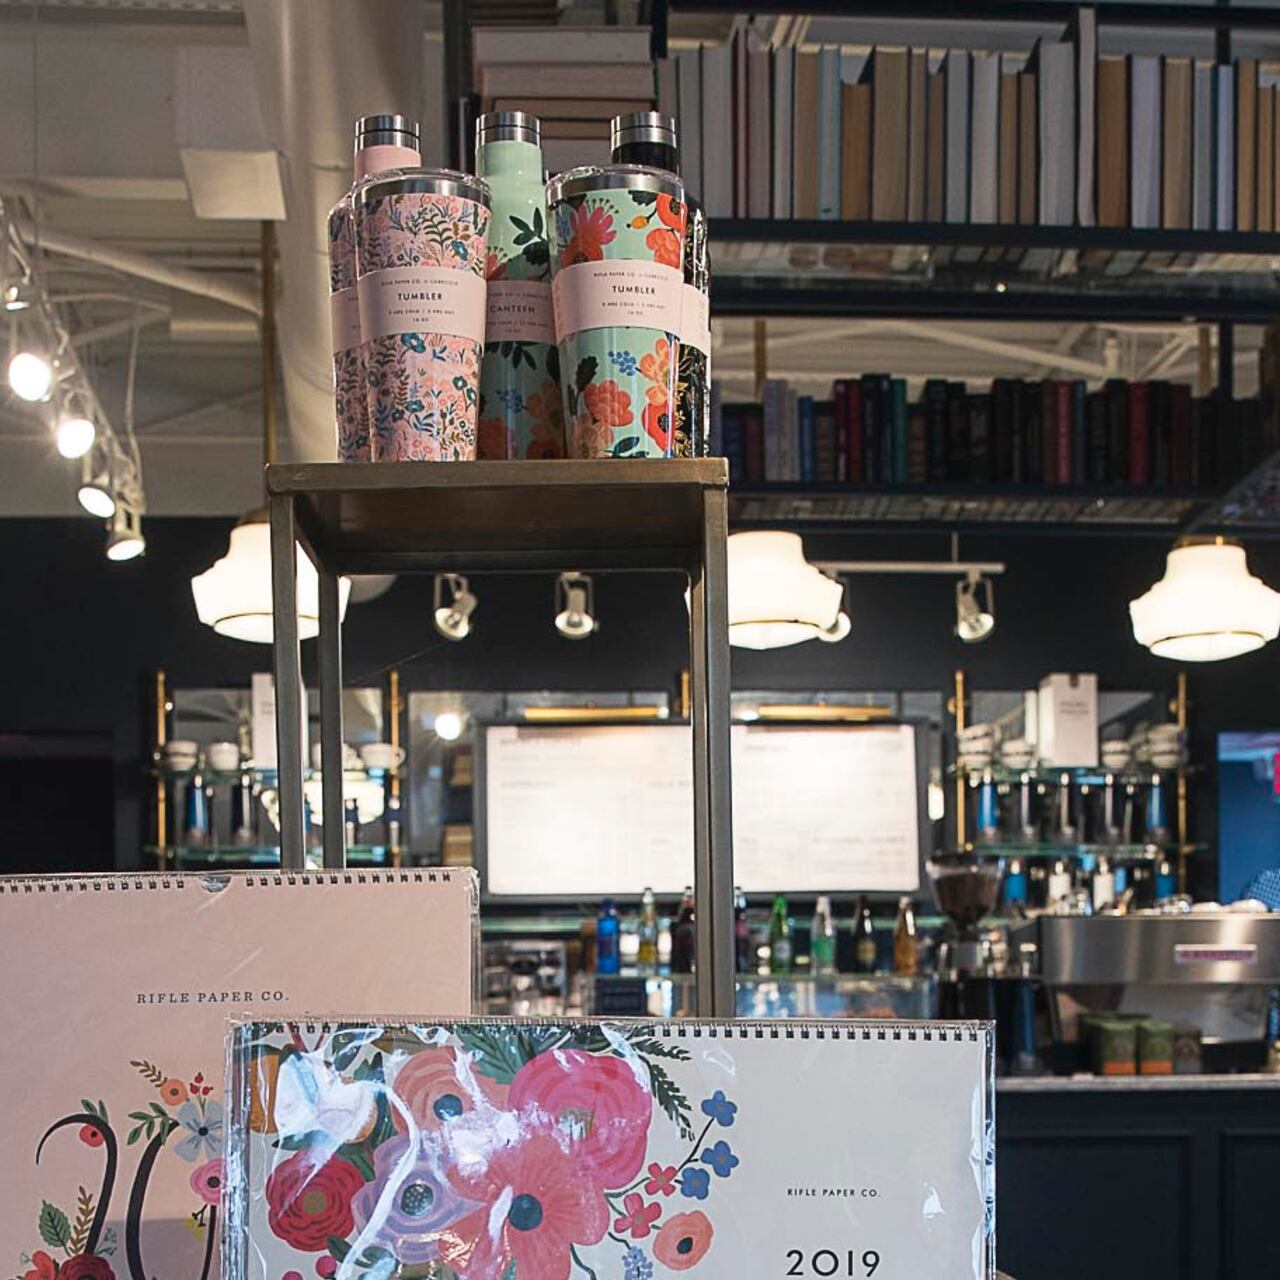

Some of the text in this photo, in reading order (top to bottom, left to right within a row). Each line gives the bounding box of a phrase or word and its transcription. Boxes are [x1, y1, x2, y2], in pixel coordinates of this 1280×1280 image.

[612, 285, 656, 295] TUMBLER
[397, 292, 443, 301] TUMBLER
[489, 304, 535, 313] CANTEEN
[136, 990, 290, 1004] RIFLE PAPER CO.
[787, 1188, 882, 1198] RIFLE PAPER CO.
[785, 1249, 881, 1278] 2019
